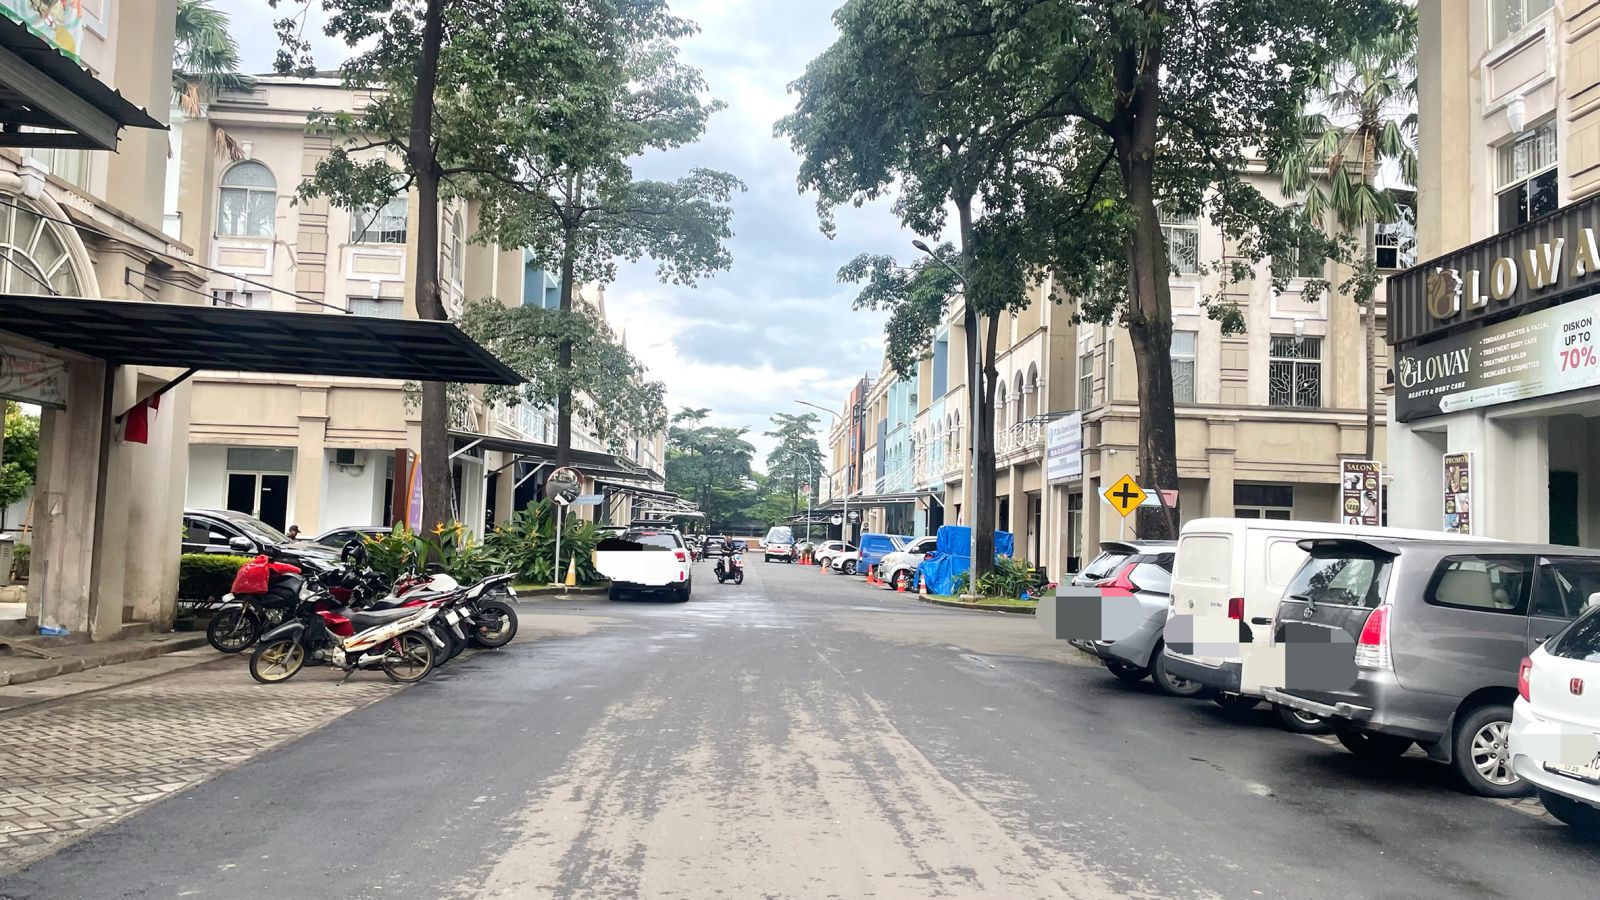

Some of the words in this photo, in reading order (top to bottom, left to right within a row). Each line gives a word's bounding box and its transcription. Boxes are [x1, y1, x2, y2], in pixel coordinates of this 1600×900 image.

[1531, 321, 1550, 331] FACIAL
[1563, 317, 1592, 332] DISKON
[1565, 335, 1576, 346] UP
[1578, 331, 1590, 343] TO
[1483, 344, 1510, 356] TREATMENT
[1511, 340, 1523, 349] BODY
[1524, 337, 1537, 345] CARE
[1483, 355, 1510, 367] TREATMENT
[1511, 352, 1527, 360] SALON
[1560, 345, 1597, 371] 70%
[1399, 347, 1472, 388] GLOWAY
[1512, 360, 1540, 372] COSMETICS
[1408, 390, 1429, 399] BEAUTY
[1434, 385, 1450, 394] BODY
[1450, 381, 1466, 390] CARE
